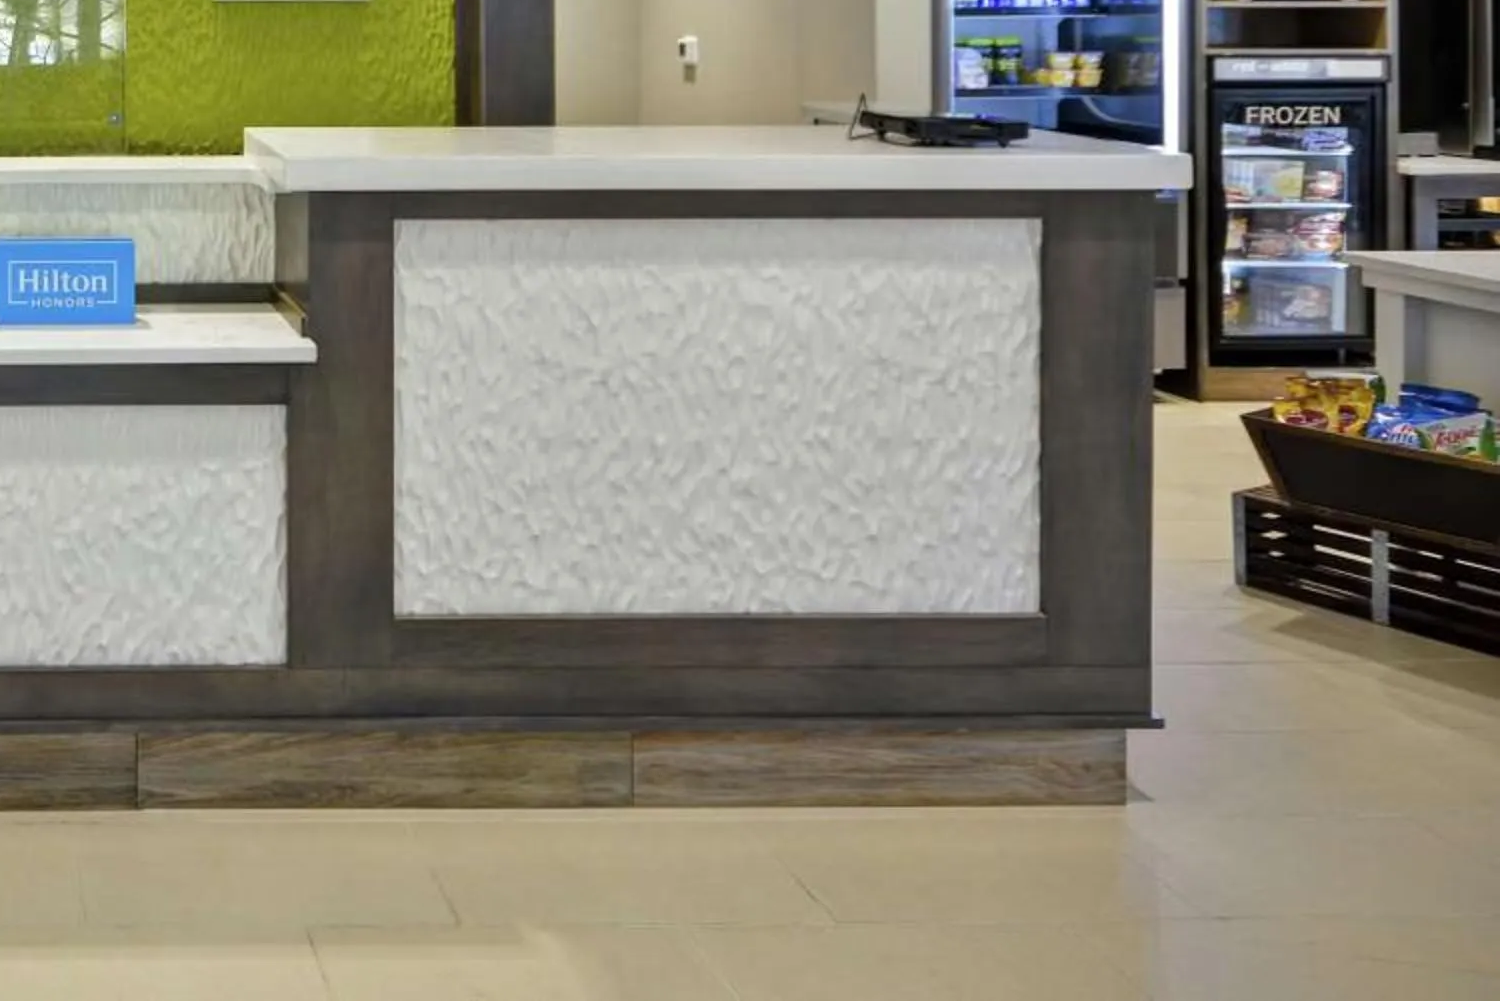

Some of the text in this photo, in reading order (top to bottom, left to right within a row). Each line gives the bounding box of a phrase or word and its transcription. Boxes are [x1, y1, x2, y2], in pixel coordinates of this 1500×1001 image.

[1245, 106, 1341, 125] FROZEN
[19, 268, 108, 293] Hilton
[30, 297, 95, 309] HONORS
